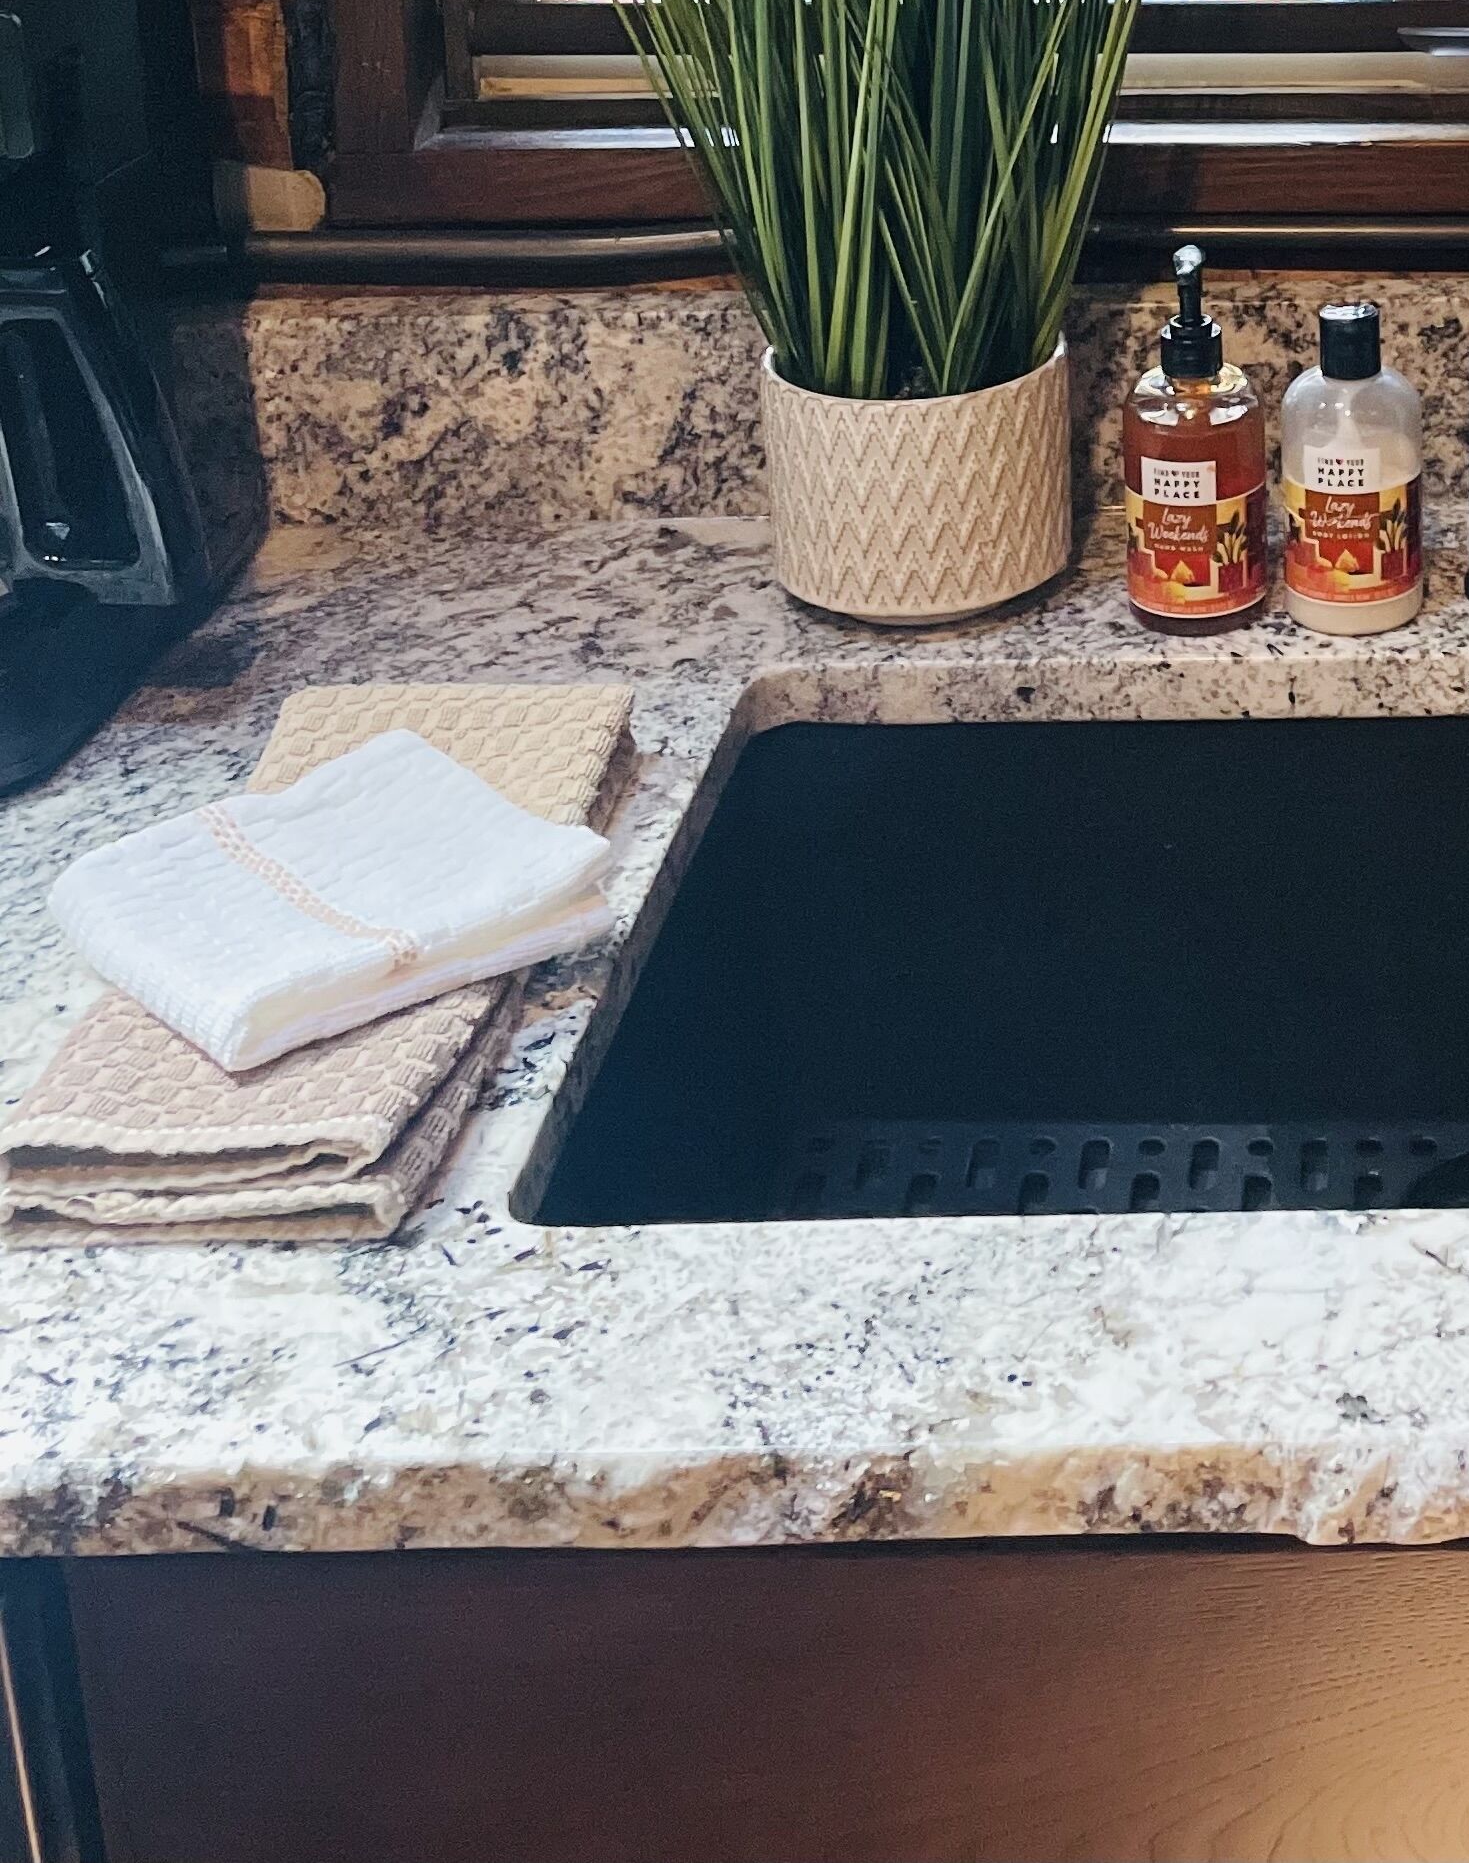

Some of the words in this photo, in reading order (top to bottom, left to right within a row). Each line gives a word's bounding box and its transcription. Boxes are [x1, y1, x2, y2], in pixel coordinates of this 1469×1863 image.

[1317, 467, 1364, 477] HAPPY
[1154, 478, 1200, 489] HAPPY
[1317, 477, 1364, 488] PLACE
[1154, 488, 1200, 499] PLACE
[1325, 496, 1355, 519] Lazy
[1161, 507, 1192, 530] Lazy
